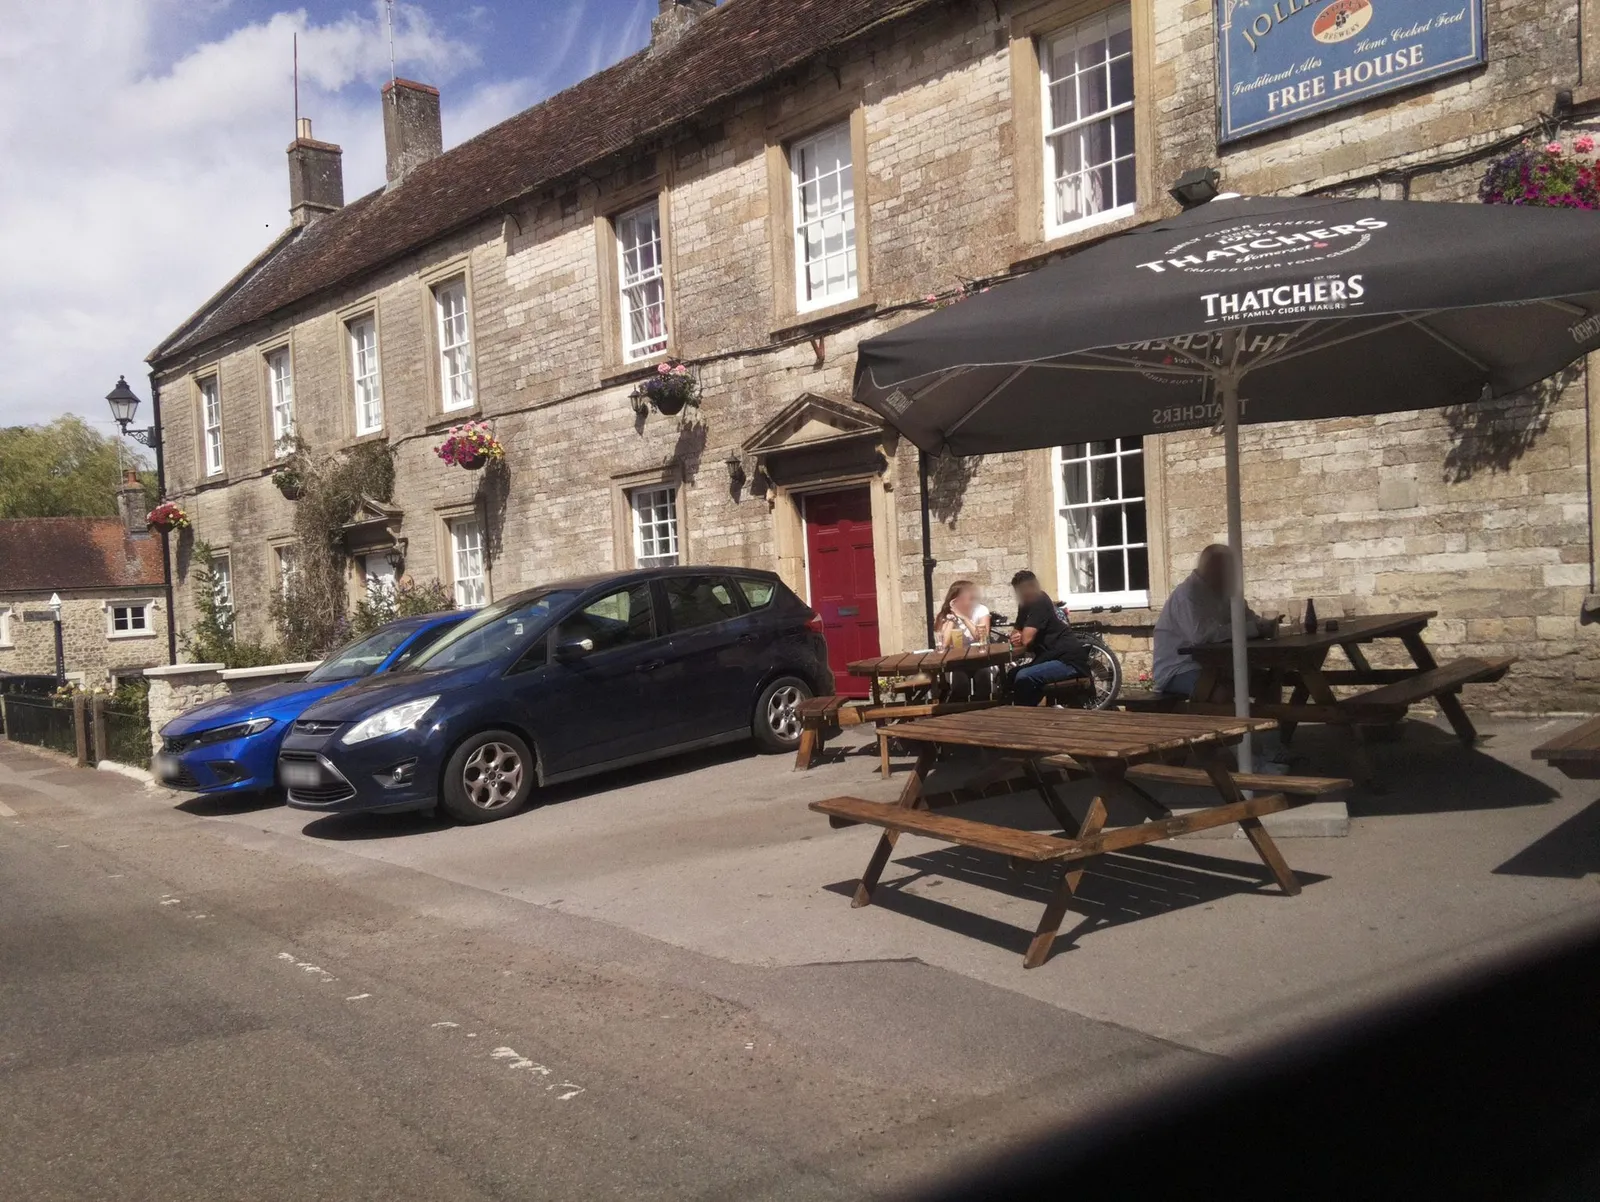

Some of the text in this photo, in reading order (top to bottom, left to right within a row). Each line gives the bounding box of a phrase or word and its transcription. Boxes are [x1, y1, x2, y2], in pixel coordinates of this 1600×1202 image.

[1353, 8, 1465, 55] Home Cooked Food
[1231, 57, 1323, 96] Traditional Ales
[1267, 44, 1424, 113] FREE HOUSE
[1135, 217, 1389, 274] THATCHERS
[1204, 224, 1252, 238] CIDER
[1258, 219, 1325, 227] MAKERS
[1235, 244, 1312, 264] Somerset
[1243, 263, 1282, 271] OVER
[1200, 274, 1364, 317] THATCHERS
[1221, 313, 1240, 322] THE
[1242, 309, 1275, 319] FAMILY
[1278, 305, 1306, 315] CIDER
